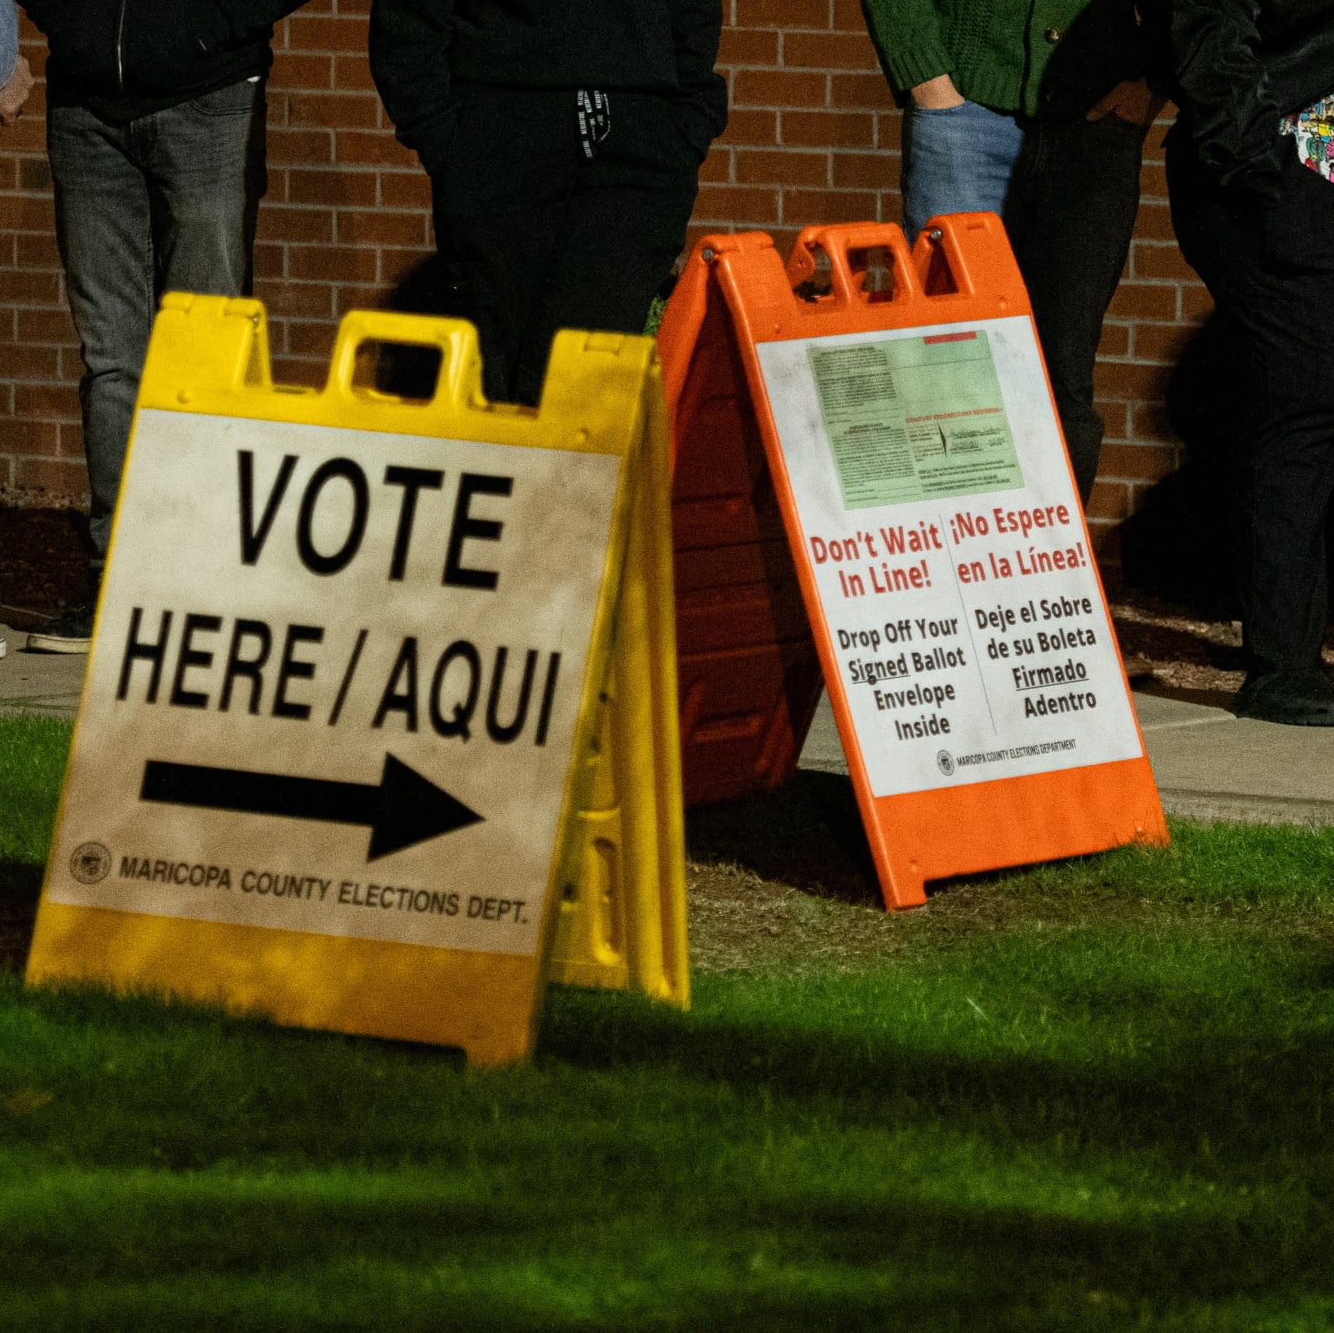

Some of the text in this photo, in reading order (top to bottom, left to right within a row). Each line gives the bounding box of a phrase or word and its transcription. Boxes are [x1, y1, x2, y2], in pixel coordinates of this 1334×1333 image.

[237, 450, 514, 590] VOTE
[949, 504, 1070, 545] ¡No Espere
[810, 521, 943, 564] Don't Wait
[839, 560, 932, 598] In Line!
[957, 542, 1087, 584] en la Línea!
[974, 595, 1092, 632] Deje el Sobre
[837, 617, 959, 652] Drop Off Your
[987, 627, 1097, 660] de su Boleta
[848, 646, 966, 684] Signed Ballot
[1012, 659, 1088, 689] Firmado
[873, 682, 956, 711] Envelope
[1024, 691, 1097, 719] Adentro
[894, 713, 951, 741] Inside
[956, 754, 987, 767] MARICOPA
[987, 750, 1009, 763] COUNTY
[1009, 745, 1041, 759] ELECTIONS
[1040, 739, 1076, 754] DEPARTMENT
[119, 856, 232, 890] MARICOPA
[241, 869, 332, 901] COUNTY
[338, 881, 460, 916] ELECTIONS
[467, 896, 529, 924] DEPT.
